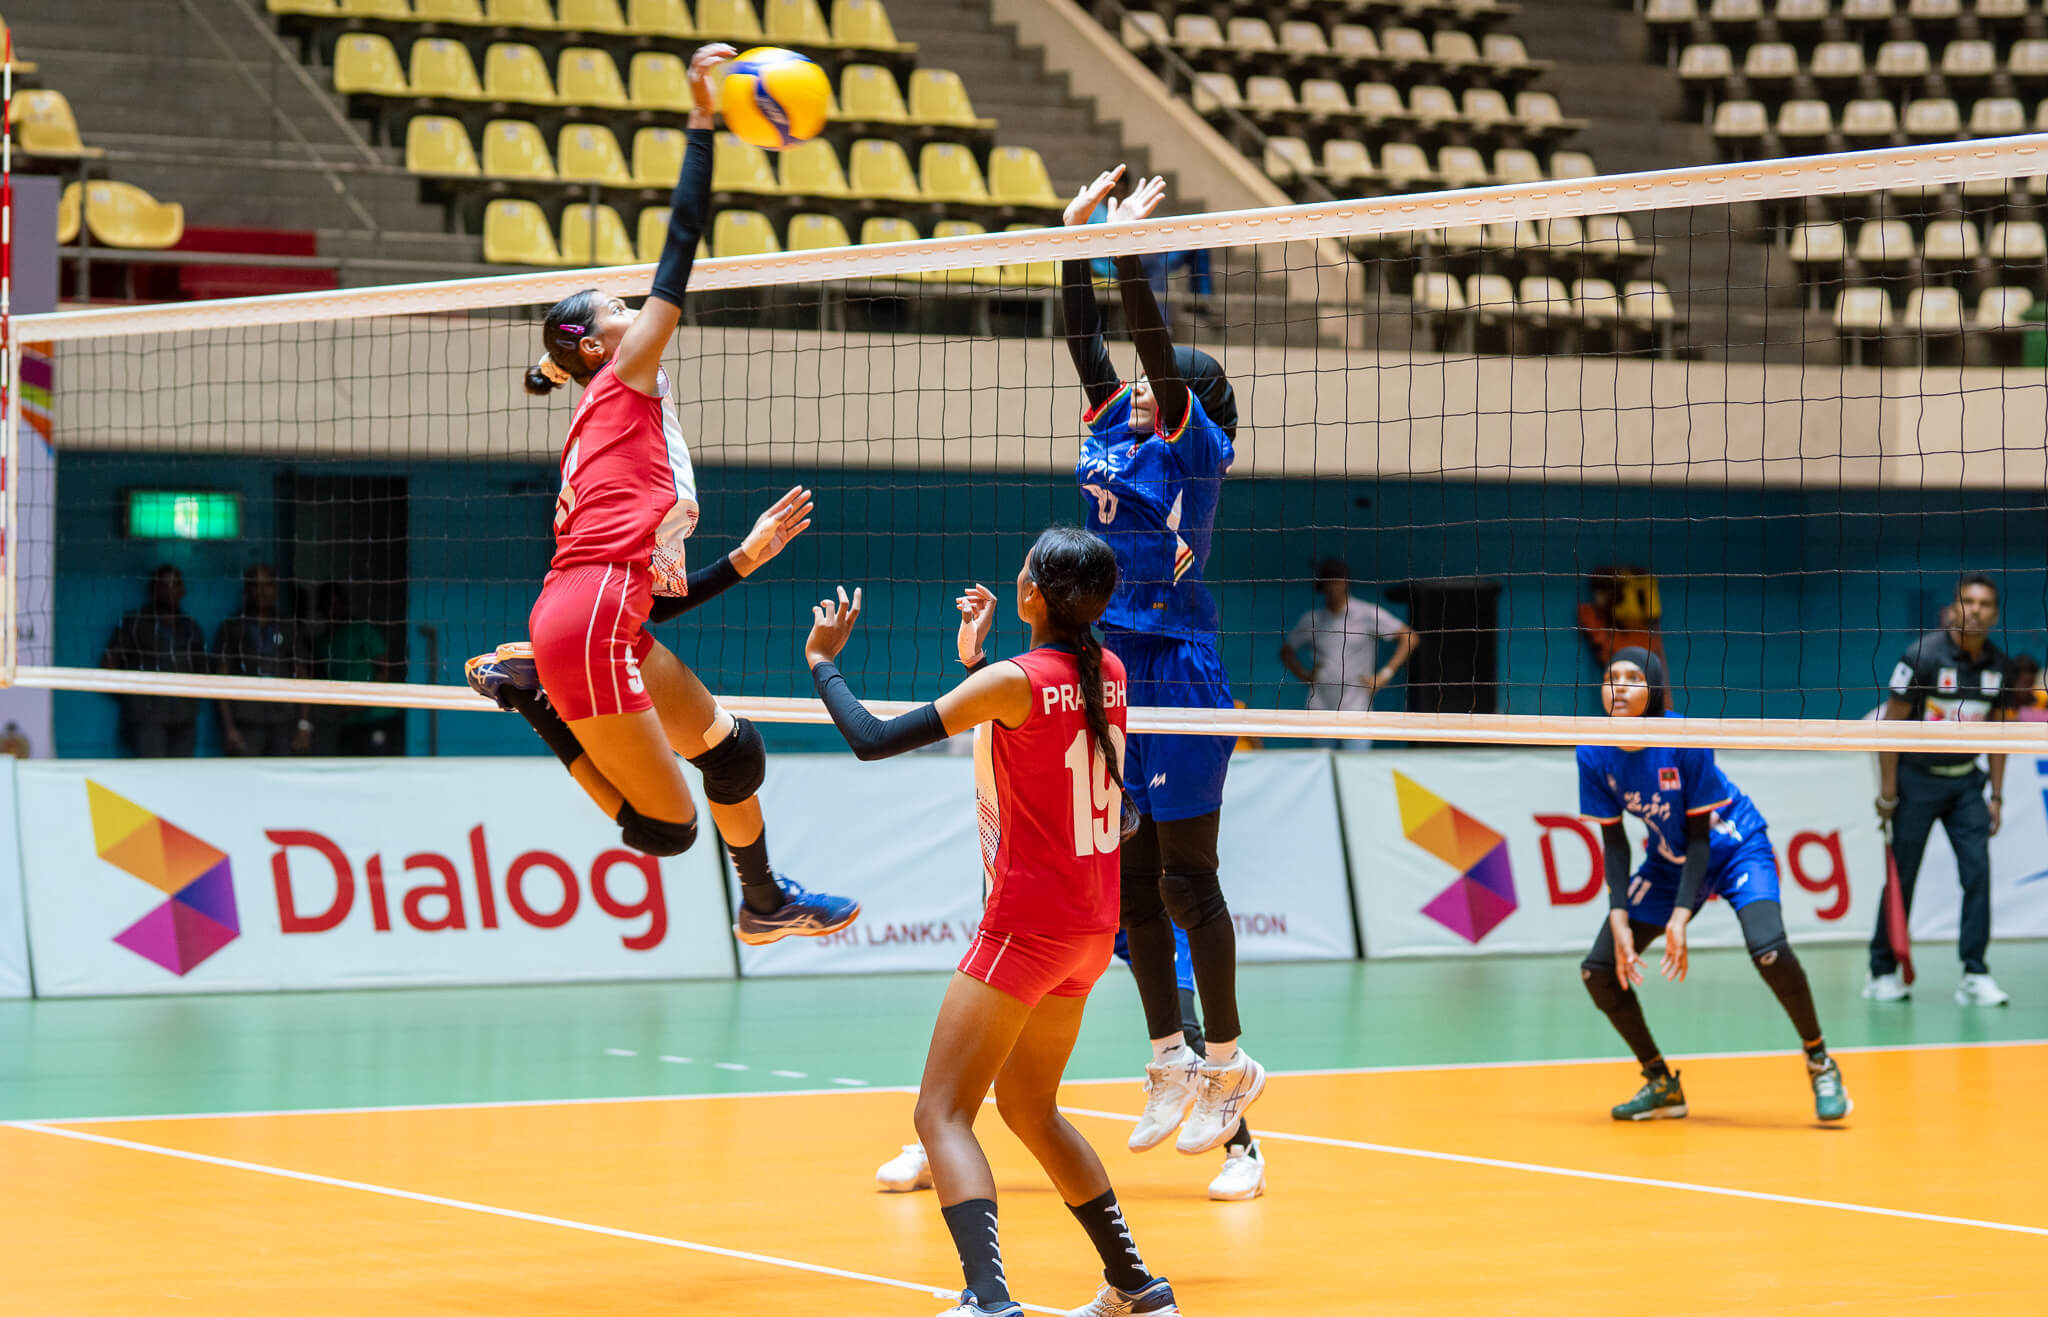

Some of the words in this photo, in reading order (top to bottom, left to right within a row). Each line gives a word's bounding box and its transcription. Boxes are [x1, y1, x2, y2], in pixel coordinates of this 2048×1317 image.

[625, 644, 645, 694] 5
[1042, 680, 1127, 715] PRABH
[1065, 724, 1126, 857] 19
[264, 823, 668, 951] Dialog
[816, 925, 858, 948] SRI
[865, 921, 955, 946] LANKA
